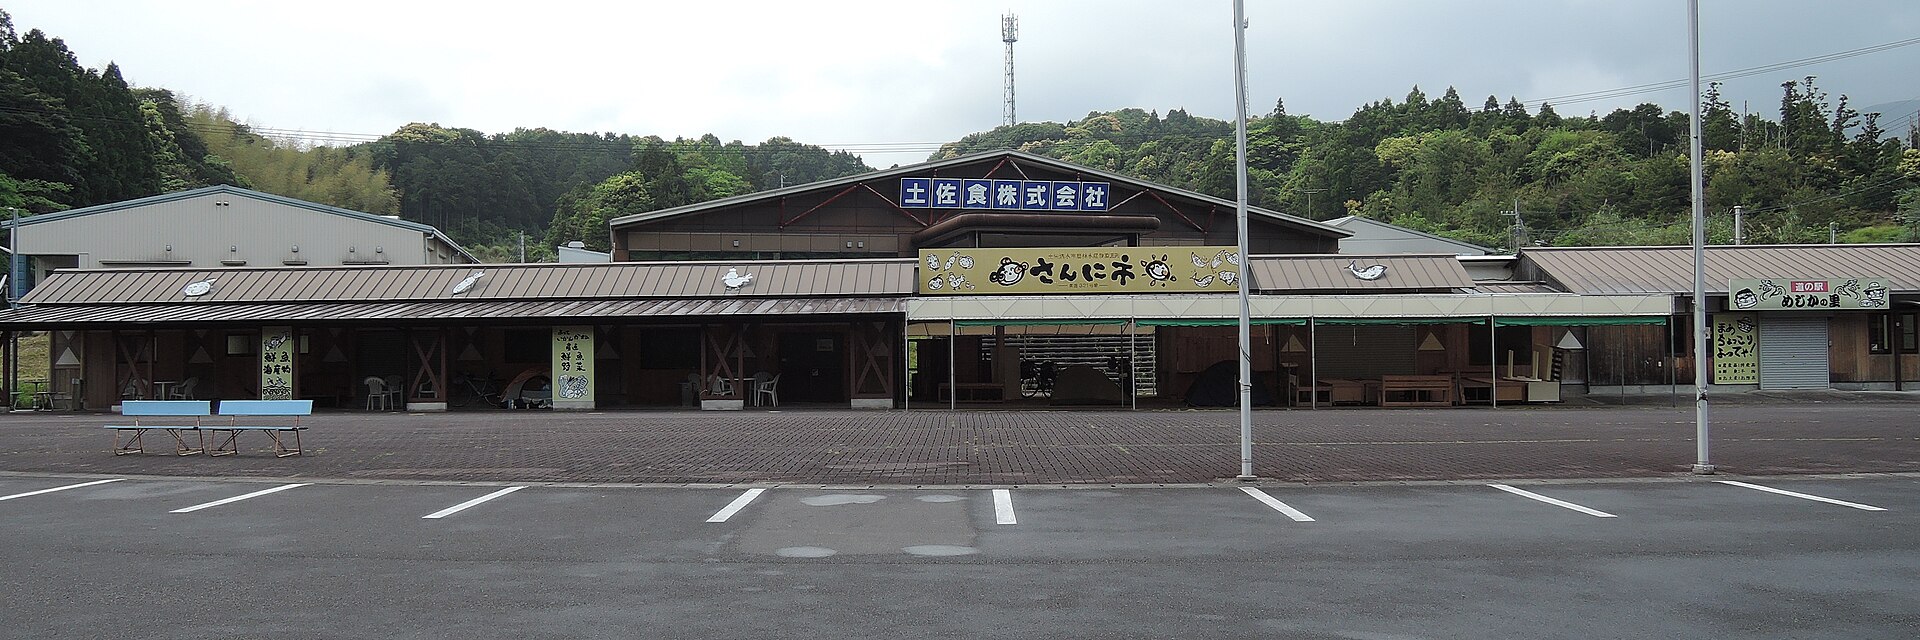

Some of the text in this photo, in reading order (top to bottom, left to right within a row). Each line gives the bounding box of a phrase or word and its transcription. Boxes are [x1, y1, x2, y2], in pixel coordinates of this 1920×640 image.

[905, 183, 1105, 207] 土佐食株式会社
[1030, 255, 1135, 286] さんに市
[1795, 282, 1824, 291] 道の駅
[1781, 294, 1841, 308] めじかの里
[263, 364, 290, 374] 海産物
